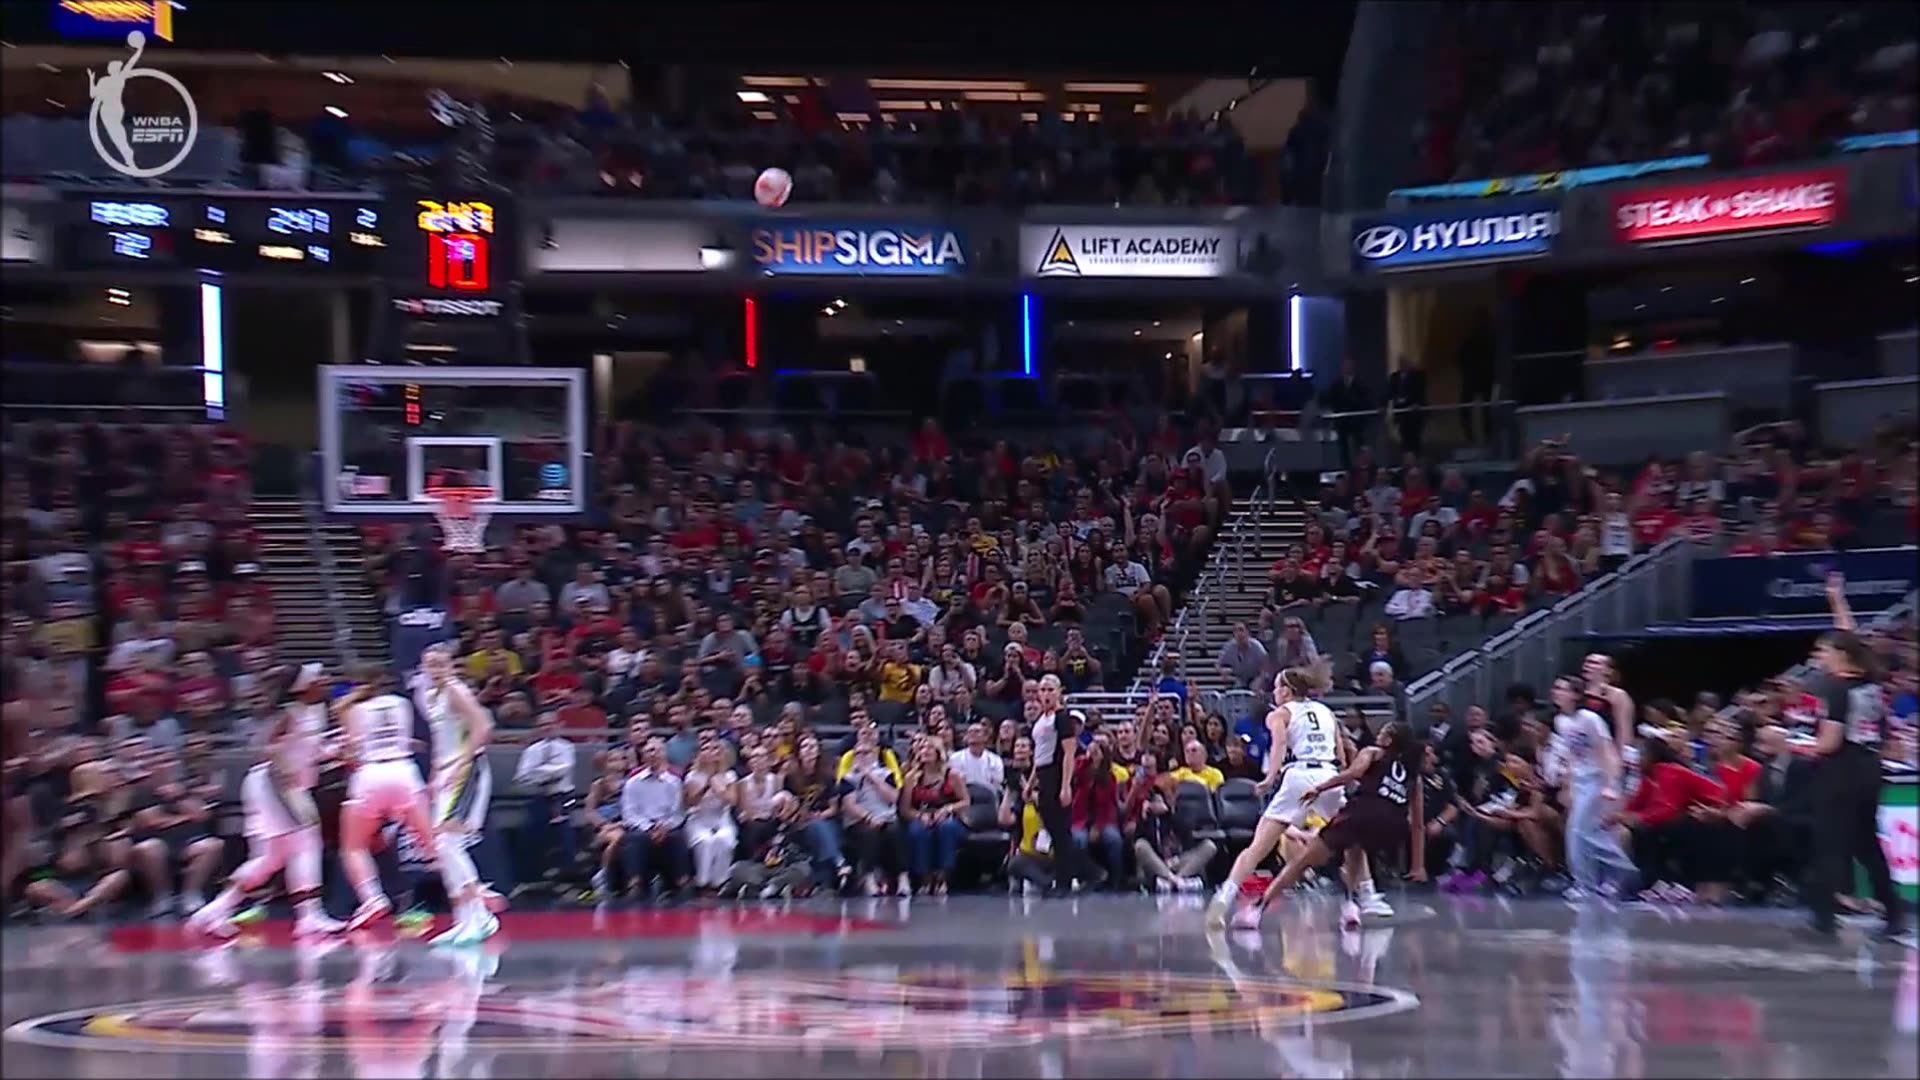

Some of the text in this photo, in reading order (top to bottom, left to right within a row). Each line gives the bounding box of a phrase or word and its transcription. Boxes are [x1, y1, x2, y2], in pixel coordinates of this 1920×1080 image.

[1616, 195, 1711, 229] STEAK
[1730, 182, 1836, 218] SHAKE
[752, 229, 966, 266] SHIPSIGMA
[1081, 238, 1220, 256] LIFT ACADEMY
[1412, 210, 1561, 251] HYUNDAI
[1306, 711, 1321, 731] 9
